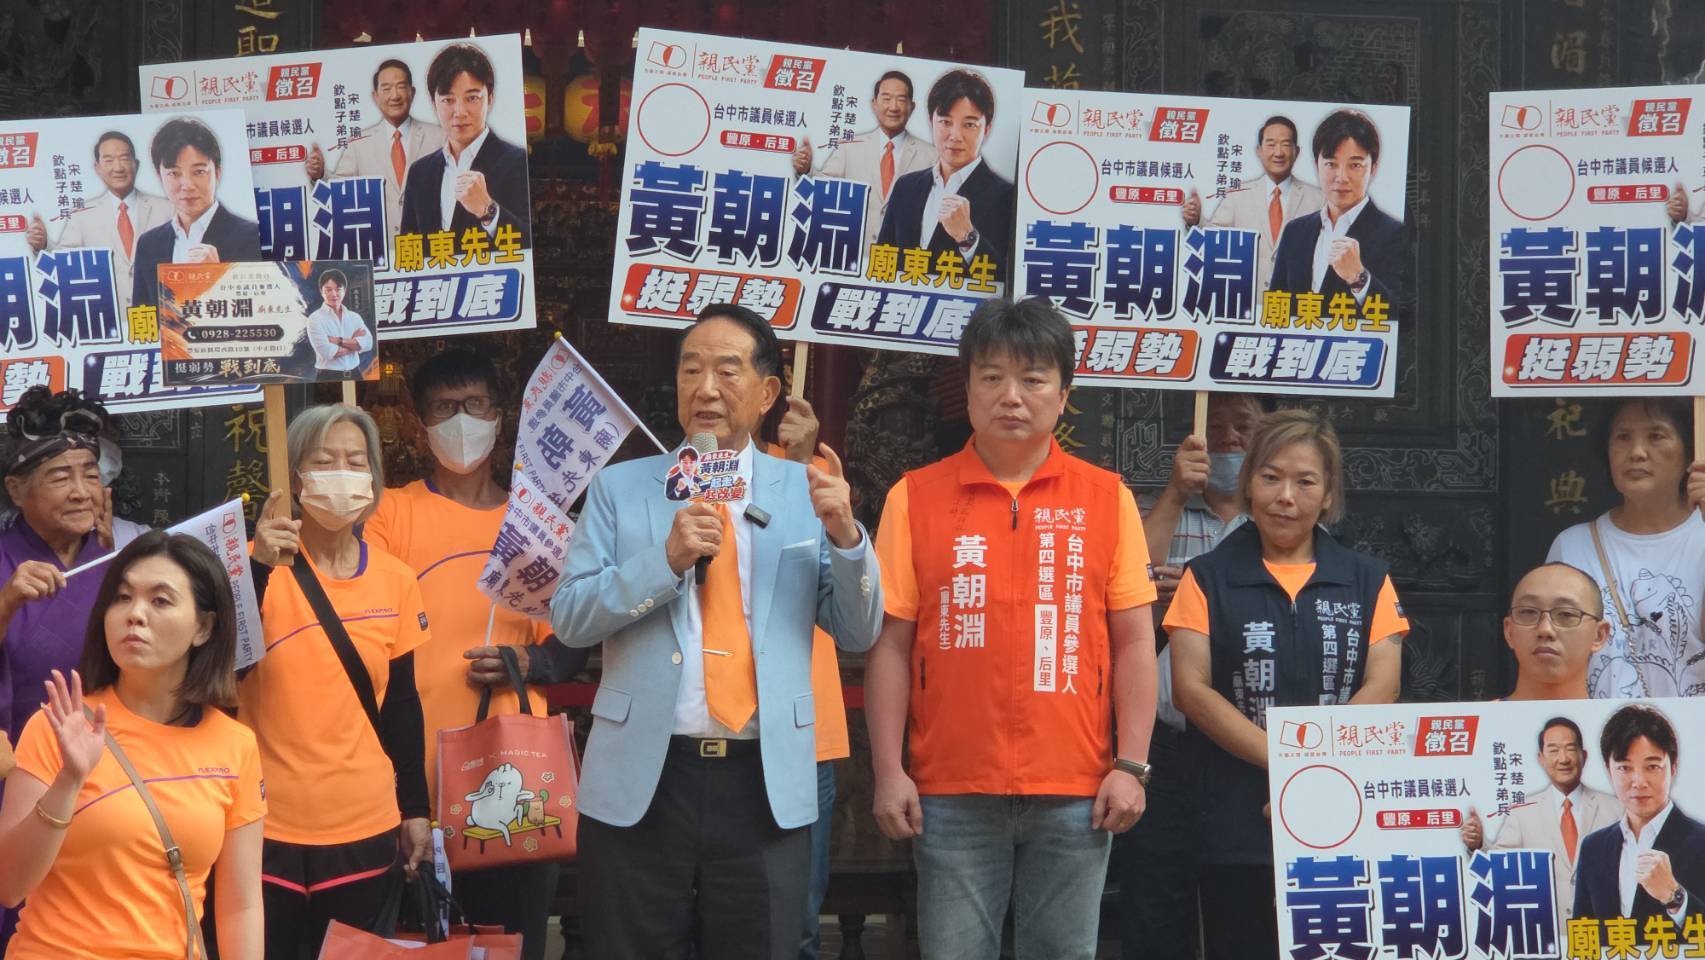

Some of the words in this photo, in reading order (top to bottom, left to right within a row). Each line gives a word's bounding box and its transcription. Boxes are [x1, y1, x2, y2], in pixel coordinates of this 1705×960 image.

[280, 66, 310, 77] 親民黨
[698, 51, 760, 77] 親民黨
[774, 68, 815, 91] 徵召
[782, 58, 814, 70] 親民黨
[200, 72, 258, 97] 親民黨
[275, 77, 314, 98] 徵召
[333, 83, 349, 150] 欽點子弟兵
[347, 92, 362, 139] 宋楚瑜
[714, 103, 808, 128] 台中市議員候選人
[827, 84, 845, 150] 欽點子弟兵
[843, 95, 858, 142] 宋楚瑜
[1083, 108, 1144, 131] 親民黨
[1166, 110, 1197, 121] 親民黨
[1555, 105, 1620, 129] 親民黨
[1638, 113, 1681, 133] 徵召
[1644, 102, 1678, 112] 親民黨
[246, 118, 314, 139] 市議員候選人
[1159, 121, 1200, 142] 徵召
[1101, 159, 1195, 180] 台中市議員候選人
[1215, 133, 1230, 200] 欽點子弟兵
[1230, 144, 1243, 190] 宋楚瑜
[1577, 156, 1679, 177] 台中市議員候選人
[52, 154, 72, 220] 欽點子弟兵
[68, 163, 85, 209] 宋楚瑜
[626, 160, 870, 277] 黃朝淵
[394, 225, 525, 272] 廟東先生
[866, 243, 998, 295] 廟東先生
[1023, 220, 1260, 325] 黃朝淵
[182, 298, 253, 319] 黃朝淵
[376, 273, 508, 326] 戰到底
[635, 267, 790, 322] 挺弱勢
[1260, 290, 1391, 332] 廟東先生
[828, 286, 978, 340] 戰到底
[201, 328, 277, 339] 0928-225530
[99, 351, 160, 398] 戰
[175, 362, 214, 375] 挺弱勢
[219, 358, 281, 378] 戰到底
[1225, 336, 1371, 382] 戰到底
[1518, 335, 1675, 383] 挺弱勢
[700, 459, 740, 474] 黃朝淵
[532, 500, 570, 541] 親民黨
[1033, 507, 1087, 524] 親民黨
[493, 521, 560, 600] 黃朝
[1038, 532, 1055, 602] 第四選區
[952, 535, 988, 649] 黃朝淵
[237, 612, 248, 637] FIRST
[1061, 534, 1085, 696] 台中市議員參選人
[1314, 599, 1361, 620] 親民黨
[241, 636, 256, 661] PARTY
[1321, 624, 1338, 691] 第四選區
[1337, 721, 1405, 748] 親民黨
[1431, 719, 1465, 730] 親民黨
[1424, 731, 1469, 754] 徵召
[1363, 778, 1472, 800] 台中市議員候選人
[1492, 742, 1511, 817] 欽點子弟兵
[1509, 753, 1526, 805] 宋楚瑜
[1286, 851, 1558, 960] 黃朝淵
[1566, 914, 1705, 960] 廟東先生
